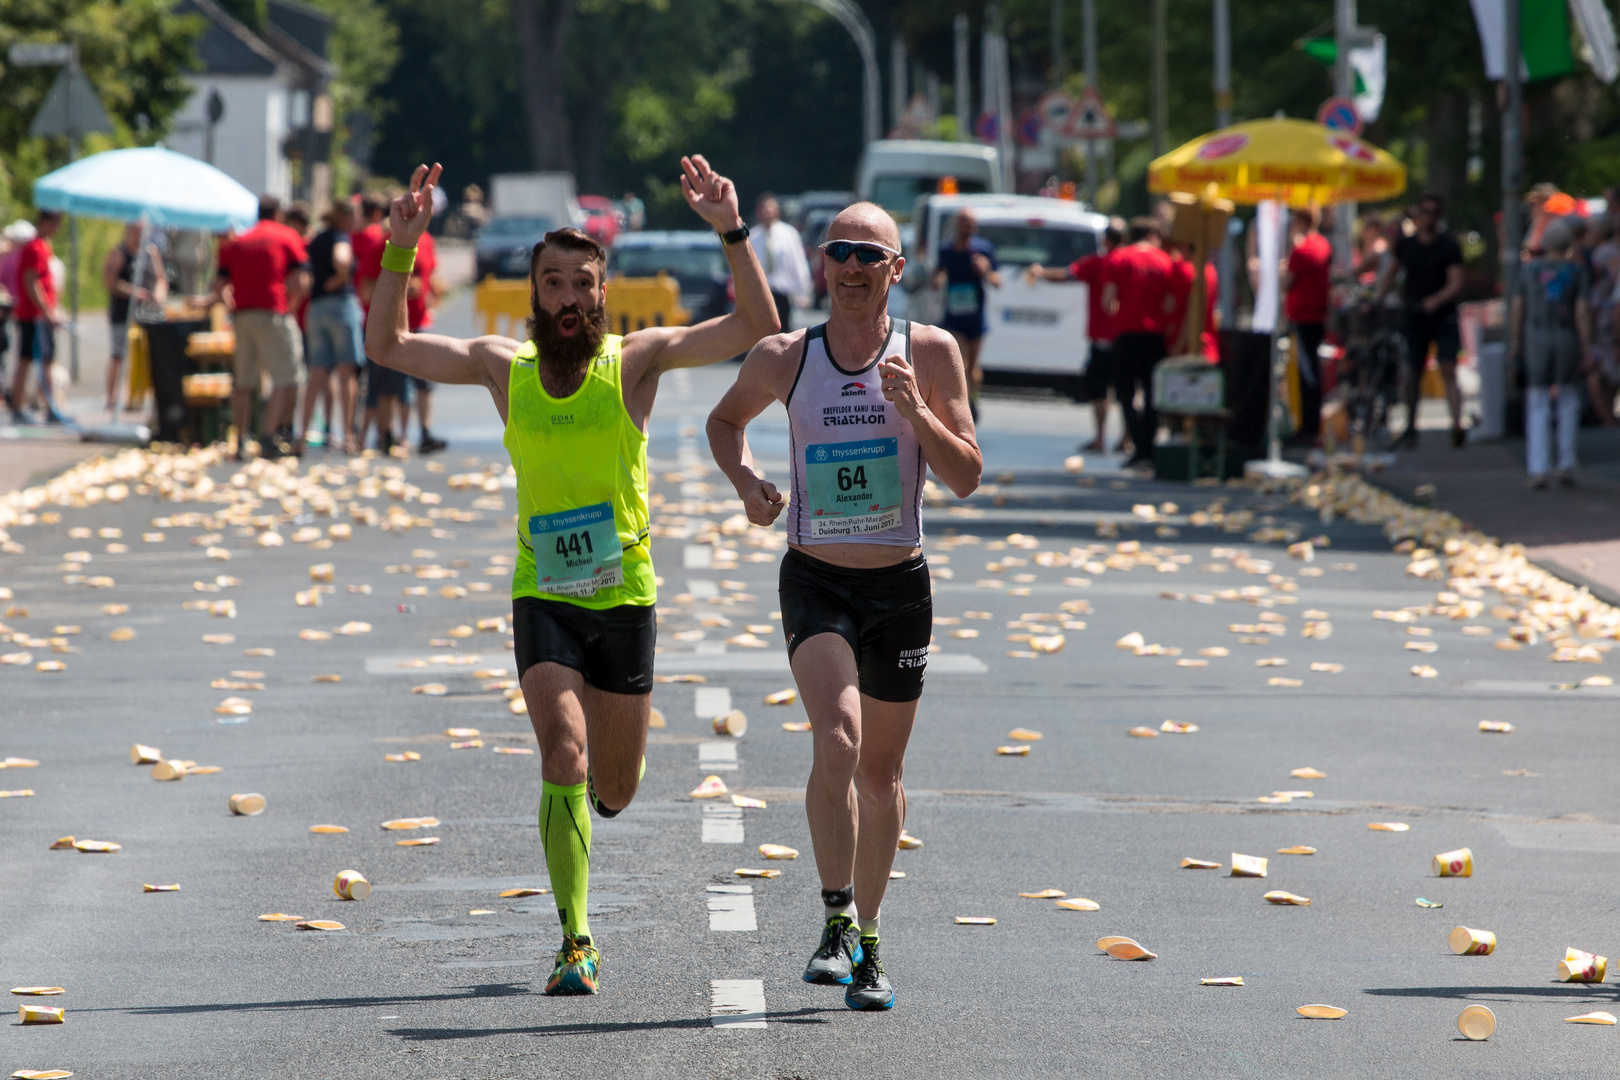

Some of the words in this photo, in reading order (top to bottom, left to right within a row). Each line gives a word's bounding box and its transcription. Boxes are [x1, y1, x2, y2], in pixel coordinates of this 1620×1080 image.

[823, 405, 852, 415] KREFELDER
[853, 404, 869, 413] KANU
[871, 404, 885, 412] KLUB
[832, 445, 886, 458] thyssenkrupp
[837, 465, 868, 492] 64
[836, 491, 873, 503] Alexander
[552, 510, 602, 527] thyssenkrupp
[828, 512, 894, 527] Rhein-Ruhr-Marathon
[818, 527, 851, 536] Duisburg
[852, 525, 863, 533] 11.
[864, 522, 880, 532] Juni
[880, 518, 895, 529] 2017
[556, 530, 594, 558] 441
[566, 556, 593, 568] Michael
[600, 576, 616, 586] 2017
